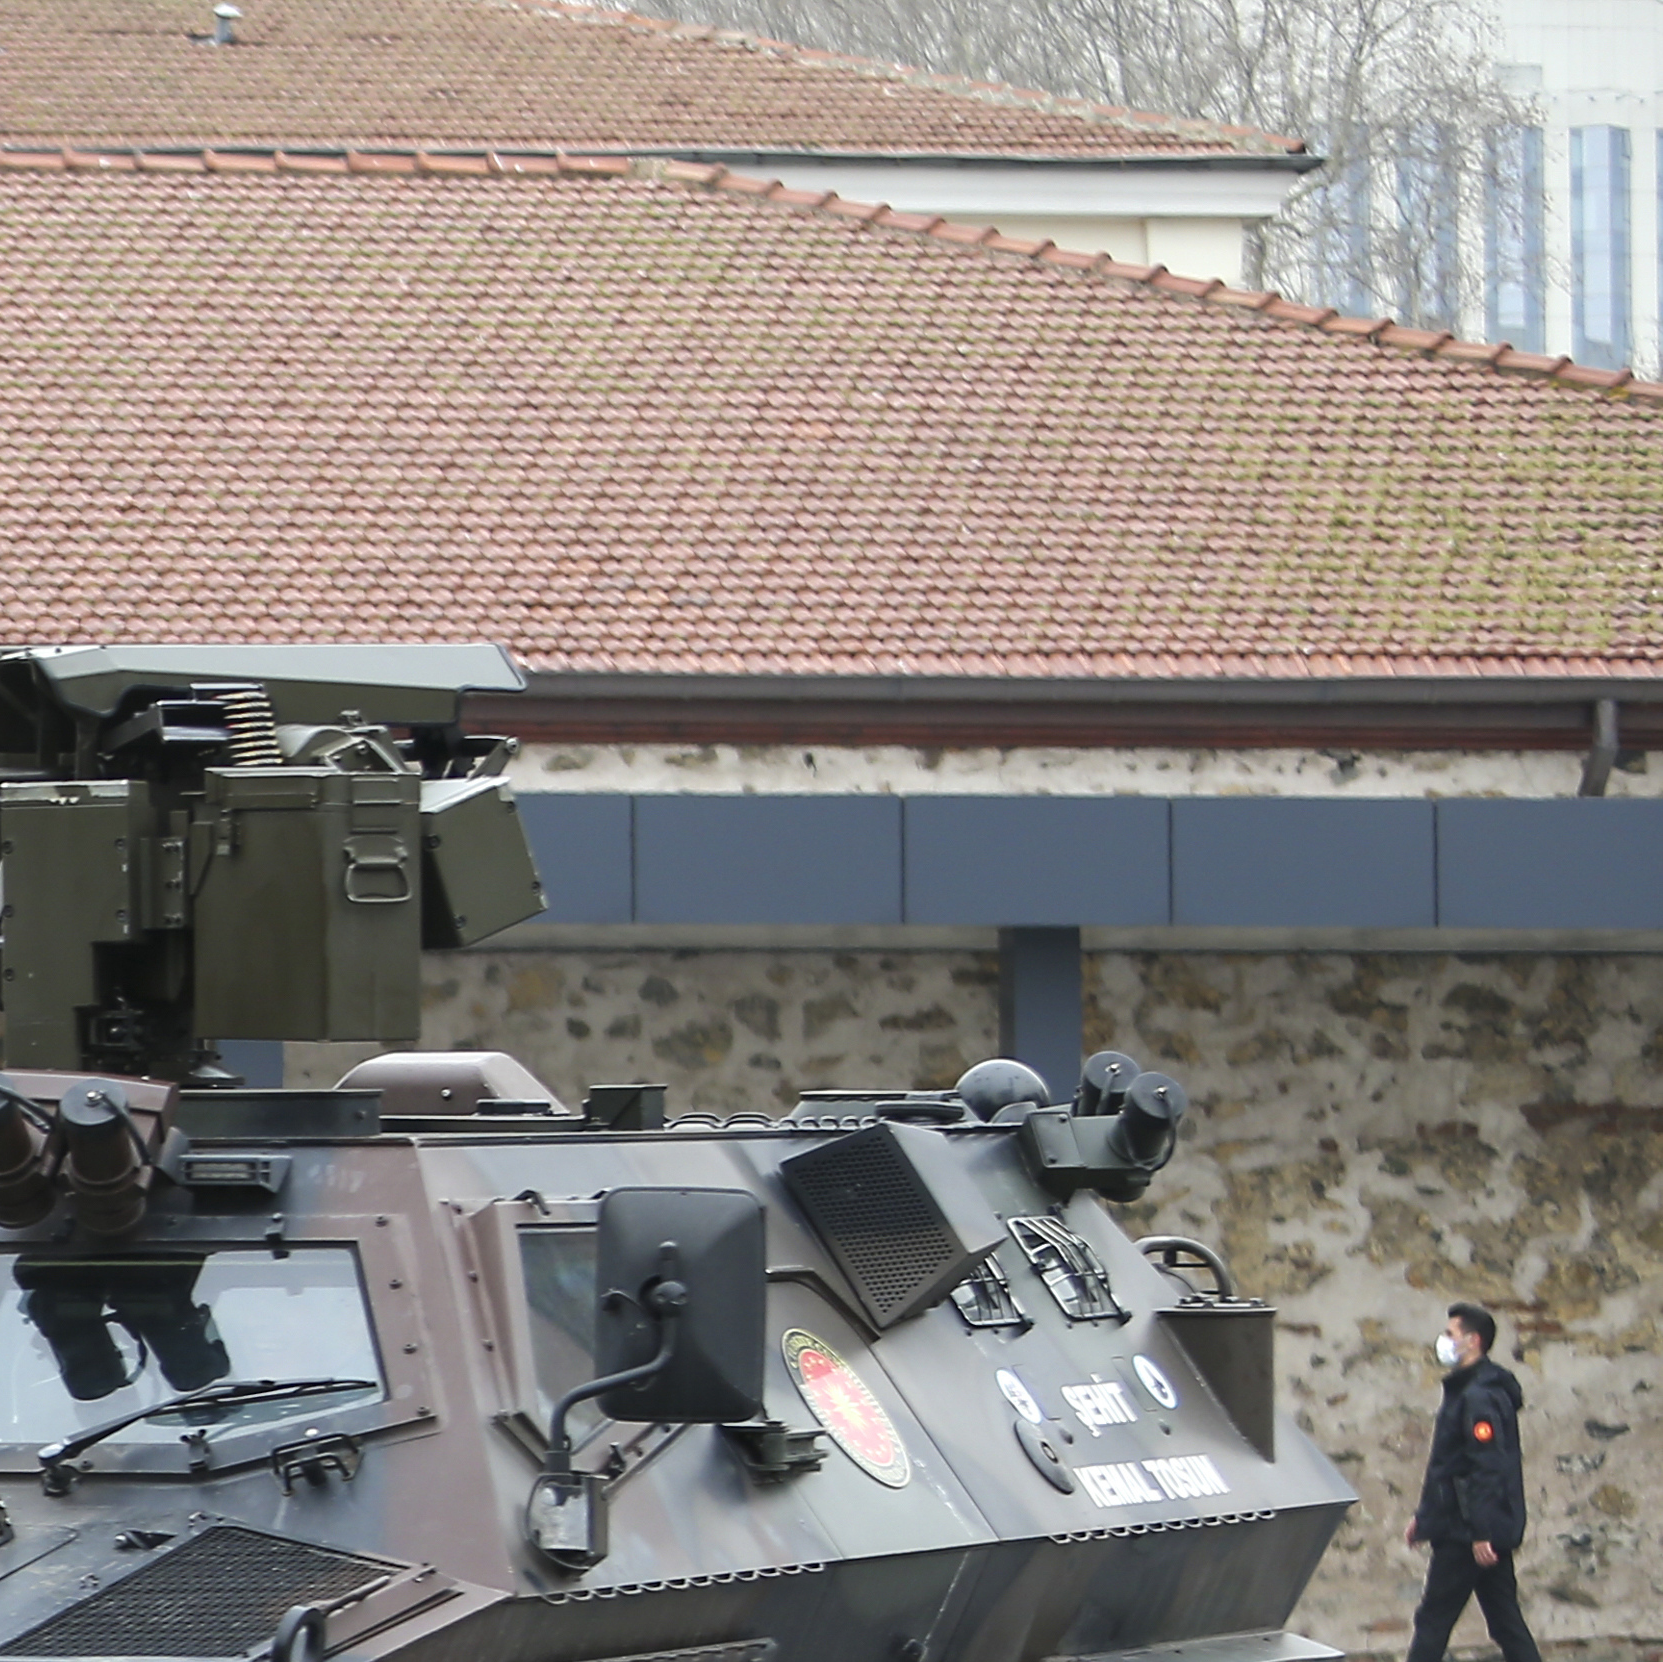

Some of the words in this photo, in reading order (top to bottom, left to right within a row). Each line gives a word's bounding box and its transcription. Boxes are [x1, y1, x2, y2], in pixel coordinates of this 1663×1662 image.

[1060, 1372, 1138, 1437] ŞEHİT
[1073, 1461, 1166, 1508] KEMAL
[1140, 1454, 1231, 1500] TOSUN
